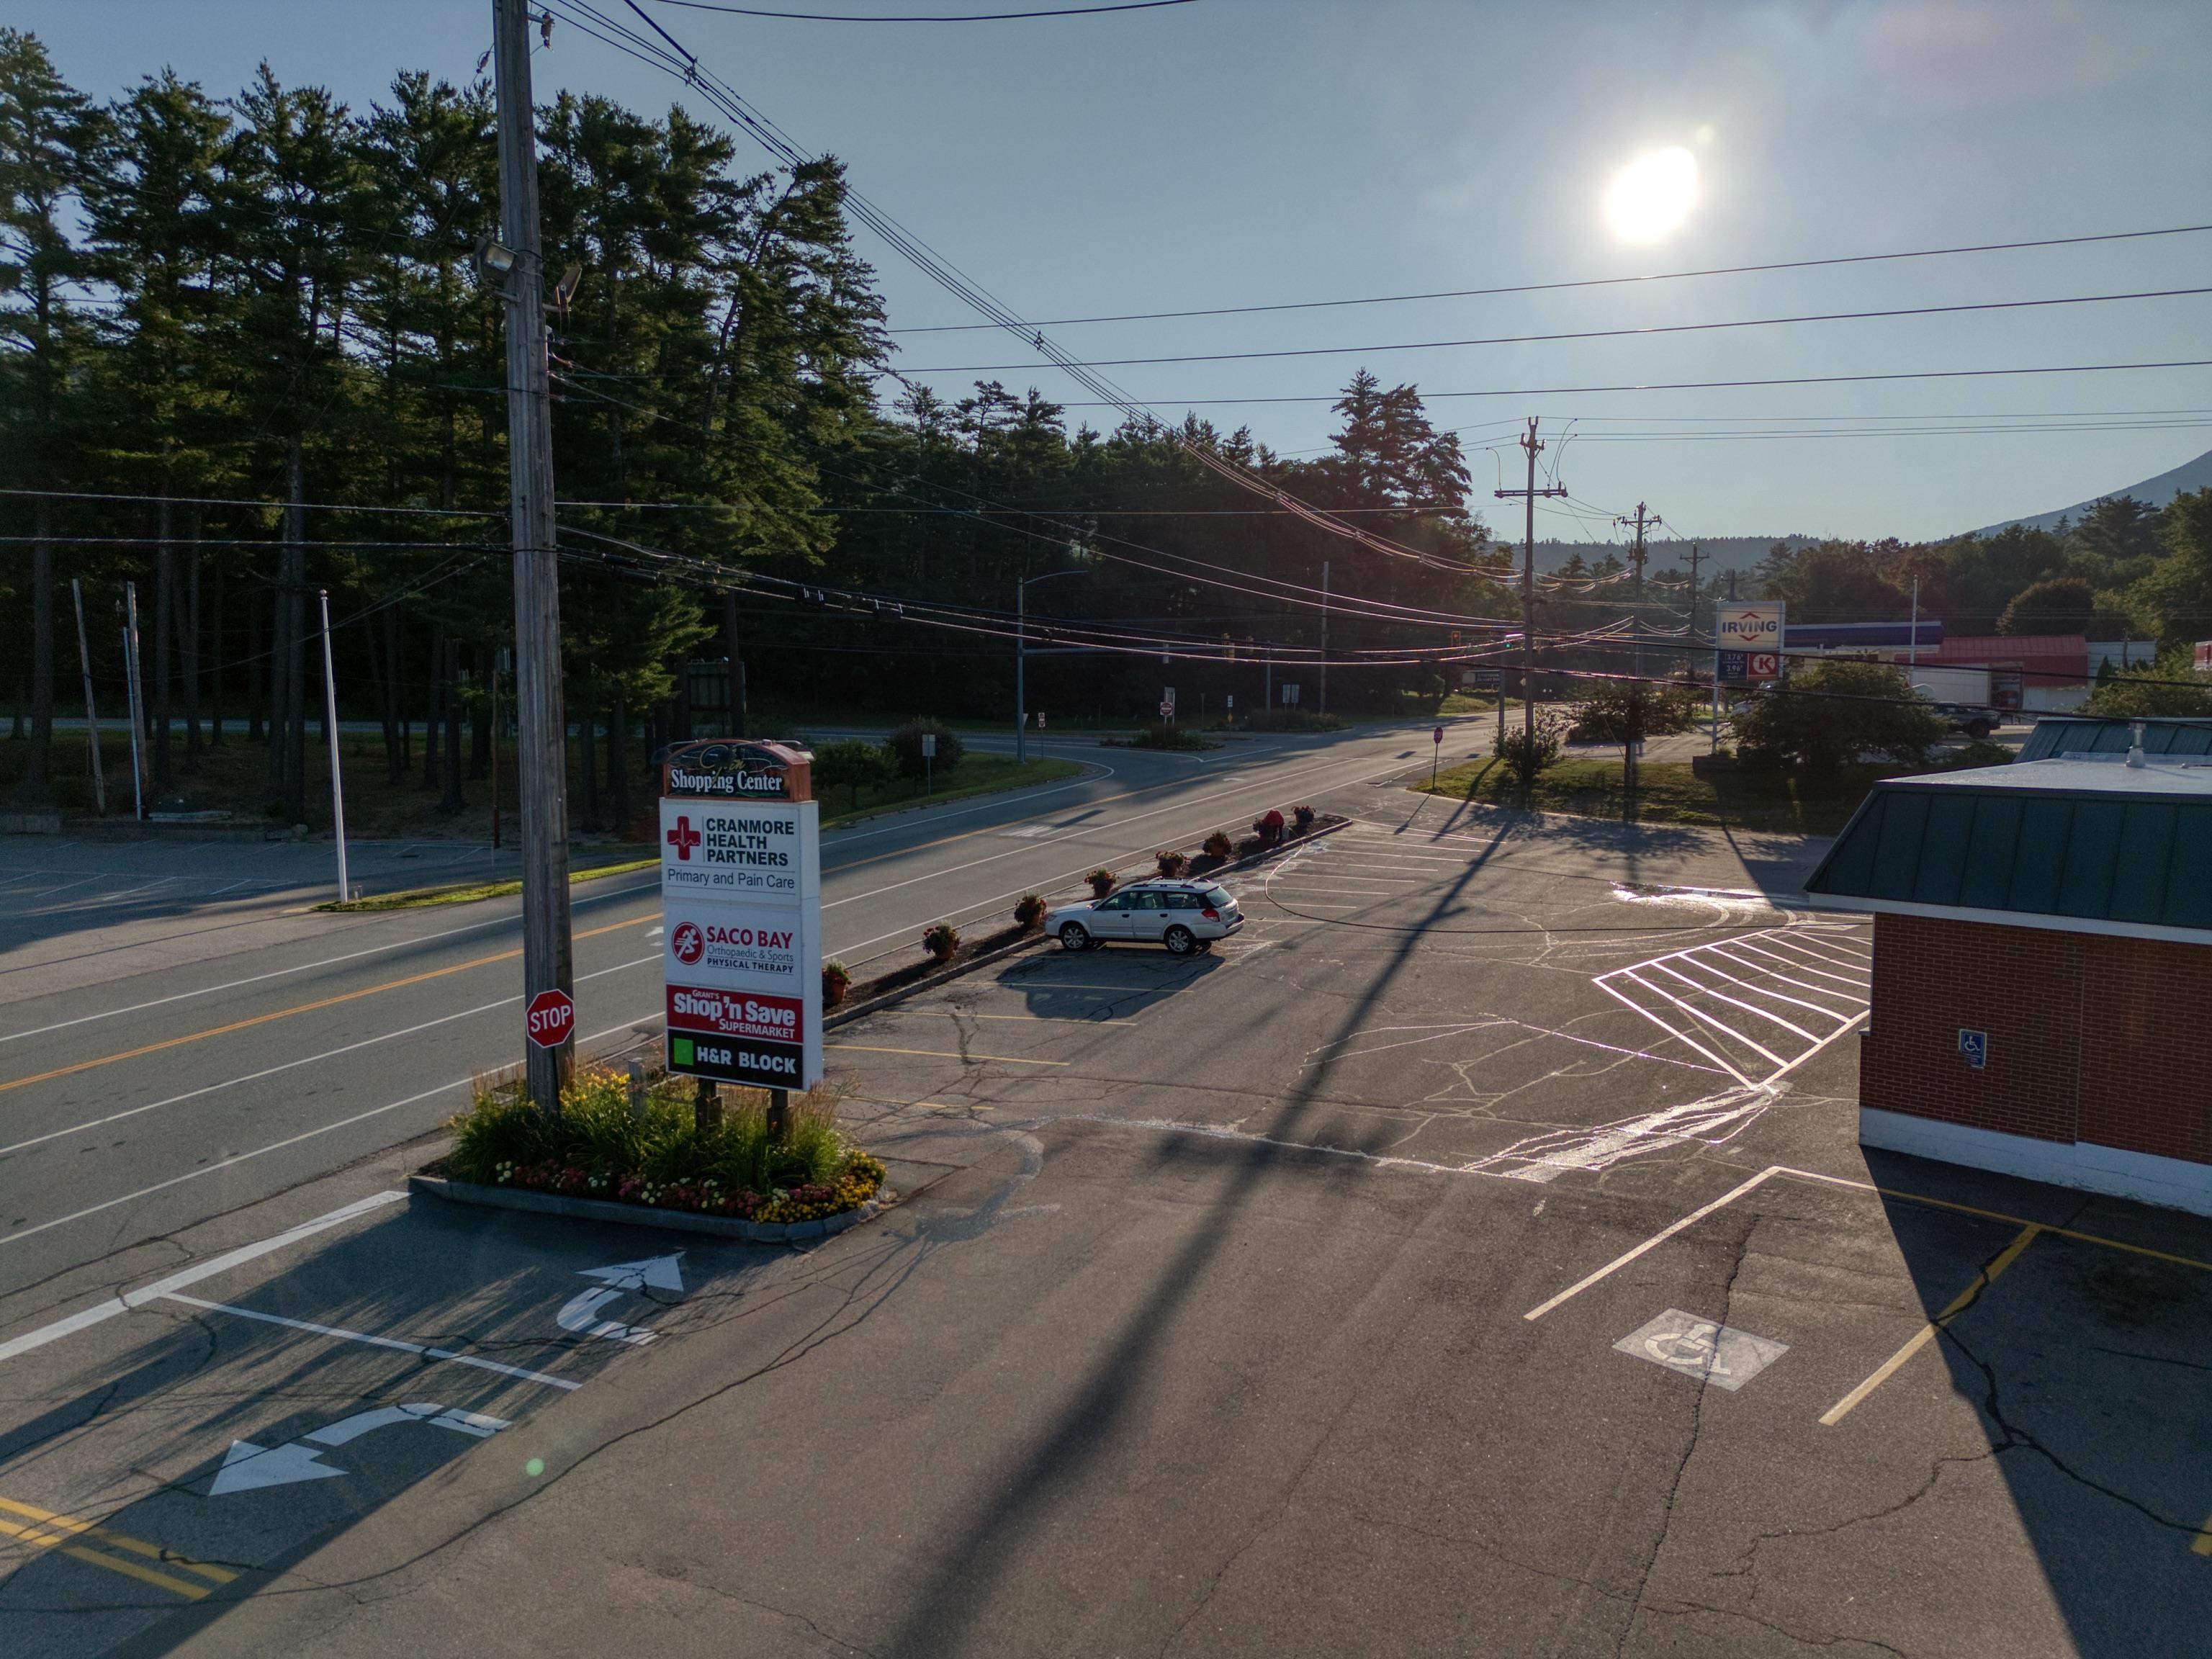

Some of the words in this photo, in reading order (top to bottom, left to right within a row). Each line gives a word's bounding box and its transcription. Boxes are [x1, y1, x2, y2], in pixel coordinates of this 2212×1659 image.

[1722, 621, 1777, 633] IRVING
[671, 769, 734, 792] Shopping
[737, 770, 783, 791] Center
[706, 818, 795, 835] CRANMORE
[706, 834, 768, 850] HEALTH
[707, 850, 788, 866] PARTNERS
[667, 868, 710, 886] Primary
[713, 872, 734, 885] and
[738, 873, 763, 887] Pain
[766, 875, 795, 889] Care
[706, 926, 753, 946] SACO
[757, 930, 793, 950] BAY
[707, 945, 757, 959] Orthopaedic
[768, 950, 793, 963] Sports
[707, 958, 750, 969] PHYSICAL
[752, 962, 793, 974] THERAPY
[530, 1004, 572, 1033] STOP
[674, 992, 722, 1021] Shop
[745, 1001, 796, 1026] Save
[719, 1018, 795, 1039] SUPERMARKET
[697, 1046, 732, 1066] H&R
[739, 1051, 796, 1074] BLOCK
